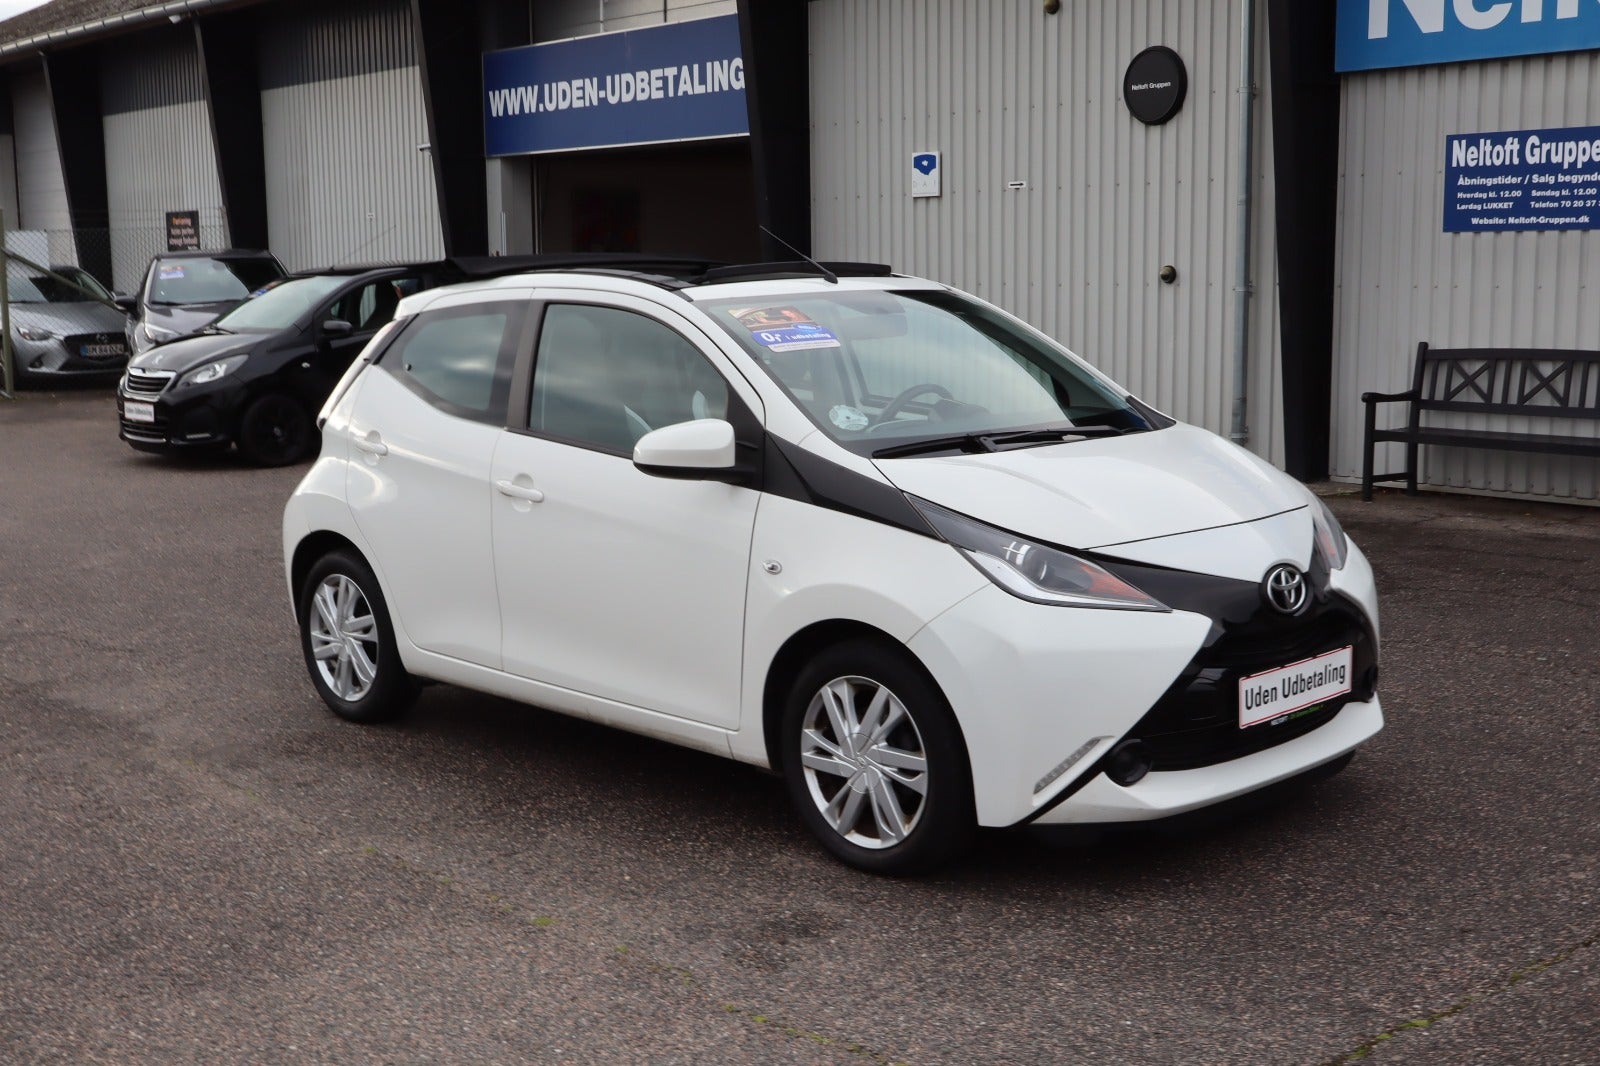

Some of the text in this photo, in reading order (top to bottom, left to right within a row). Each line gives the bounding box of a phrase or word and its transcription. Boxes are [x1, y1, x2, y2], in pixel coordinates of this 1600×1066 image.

[488, 57, 746, 118] WWW.UDEN-UDBETALING
[1452, 135, 1600, 169] Neltoft Gruppe
[1458, 174, 1522, 187] Åbningstider
[1524, 175, 1529, 184] /
[1531, 173, 1555, 184] Salg
[1457, 190, 1522, 199] Hverdag kl. 12.00
[1531, 187, 1597, 197] Søndag kl. 12.00
[1456, 201, 1514, 211] Lørdag LUKKET
[1530, 200, 1559, 209] Telefon
[1560, 200, 1571, 208] 70
[1572, 200, 1584, 208] 20
[1585, 199, 1597, 208] 37
[1471, 215, 1590, 225] Website: Neltoft-Gruppen.dk
[1245, 663, 1346, 711] Uden Udbetaling
